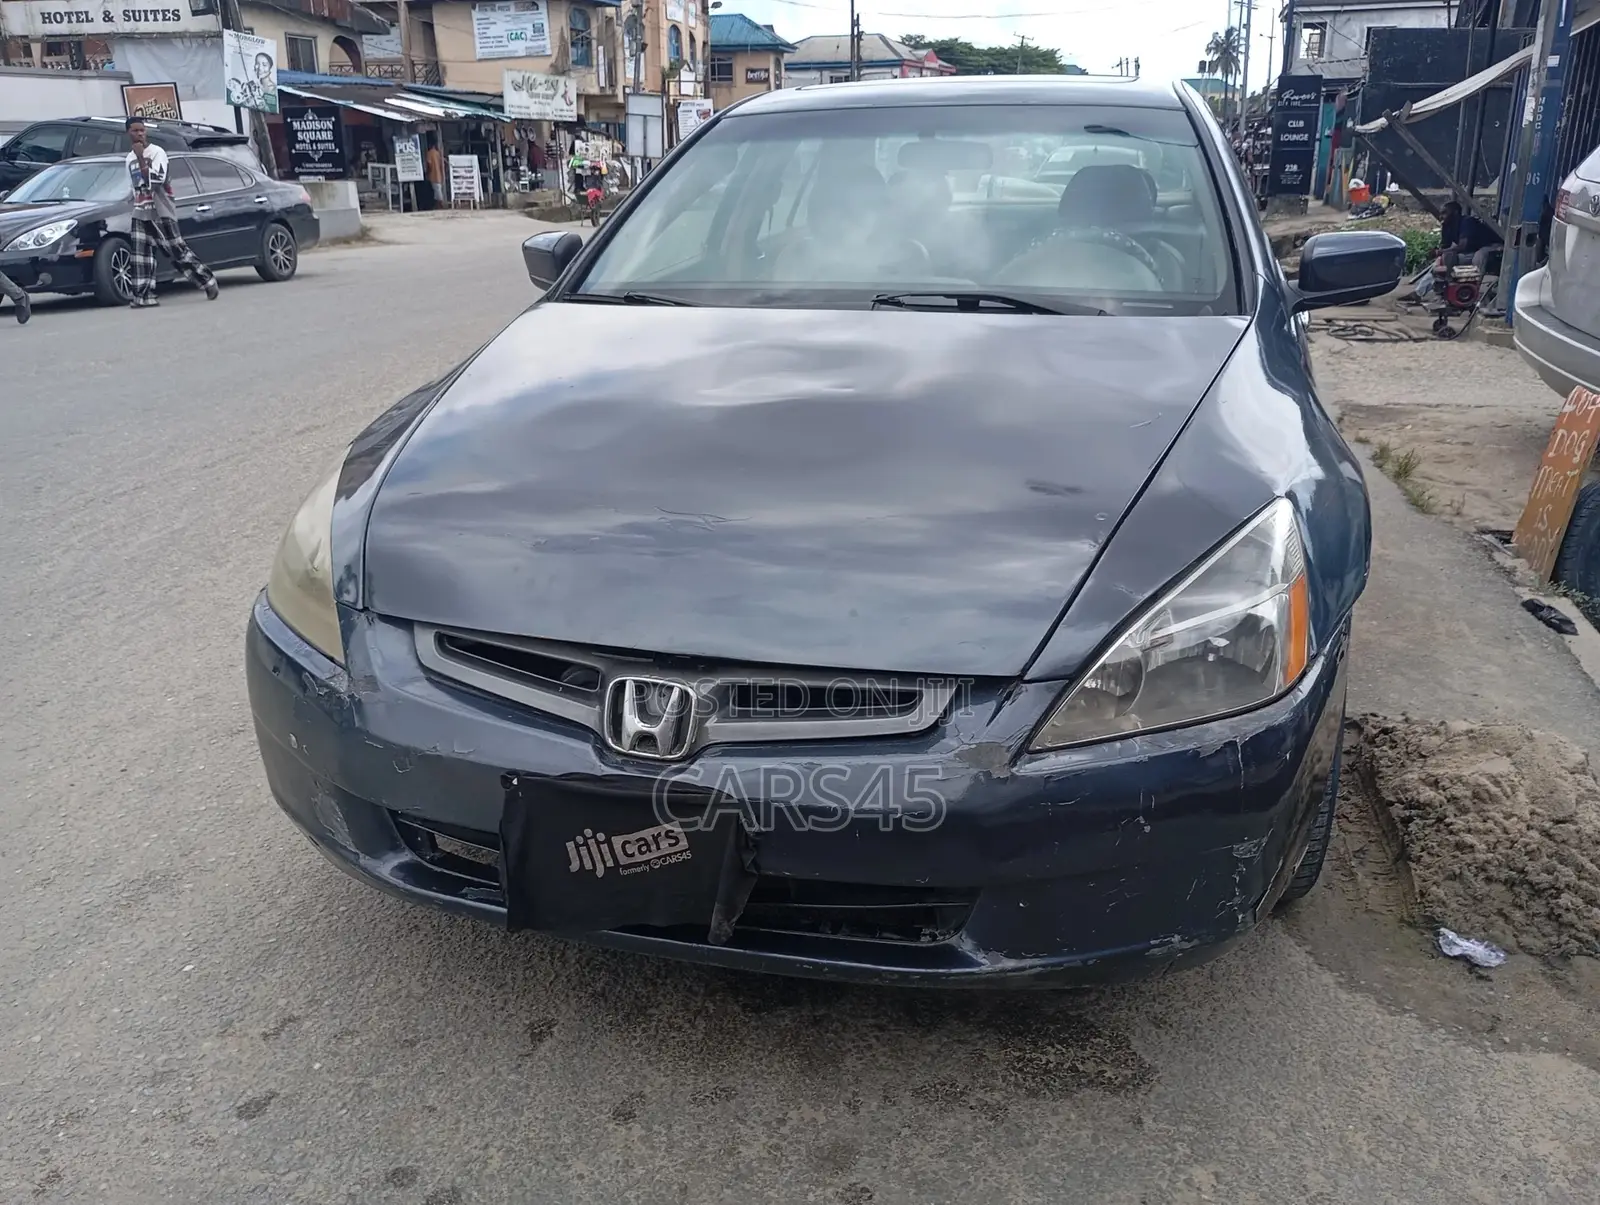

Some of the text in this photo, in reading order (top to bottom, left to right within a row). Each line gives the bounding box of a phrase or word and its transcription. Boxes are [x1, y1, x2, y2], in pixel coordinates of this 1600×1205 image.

[40, 9, 181, 24] HOTEL & SUITES
[292, 120, 334, 130] MADISON
[1287, 120, 1304, 128] CLUB
[297, 131, 334, 143] SQUARE
[1280, 133, 1309, 141] LOUNGE
[1547, 428, 1591, 464] DOG
[1531, 464, 1580, 500] MEAT
[1533, 503, 1553, 531] IS
[565, 828, 681, 879] Jiji cars
[619, 863, 651, 875] formerly
